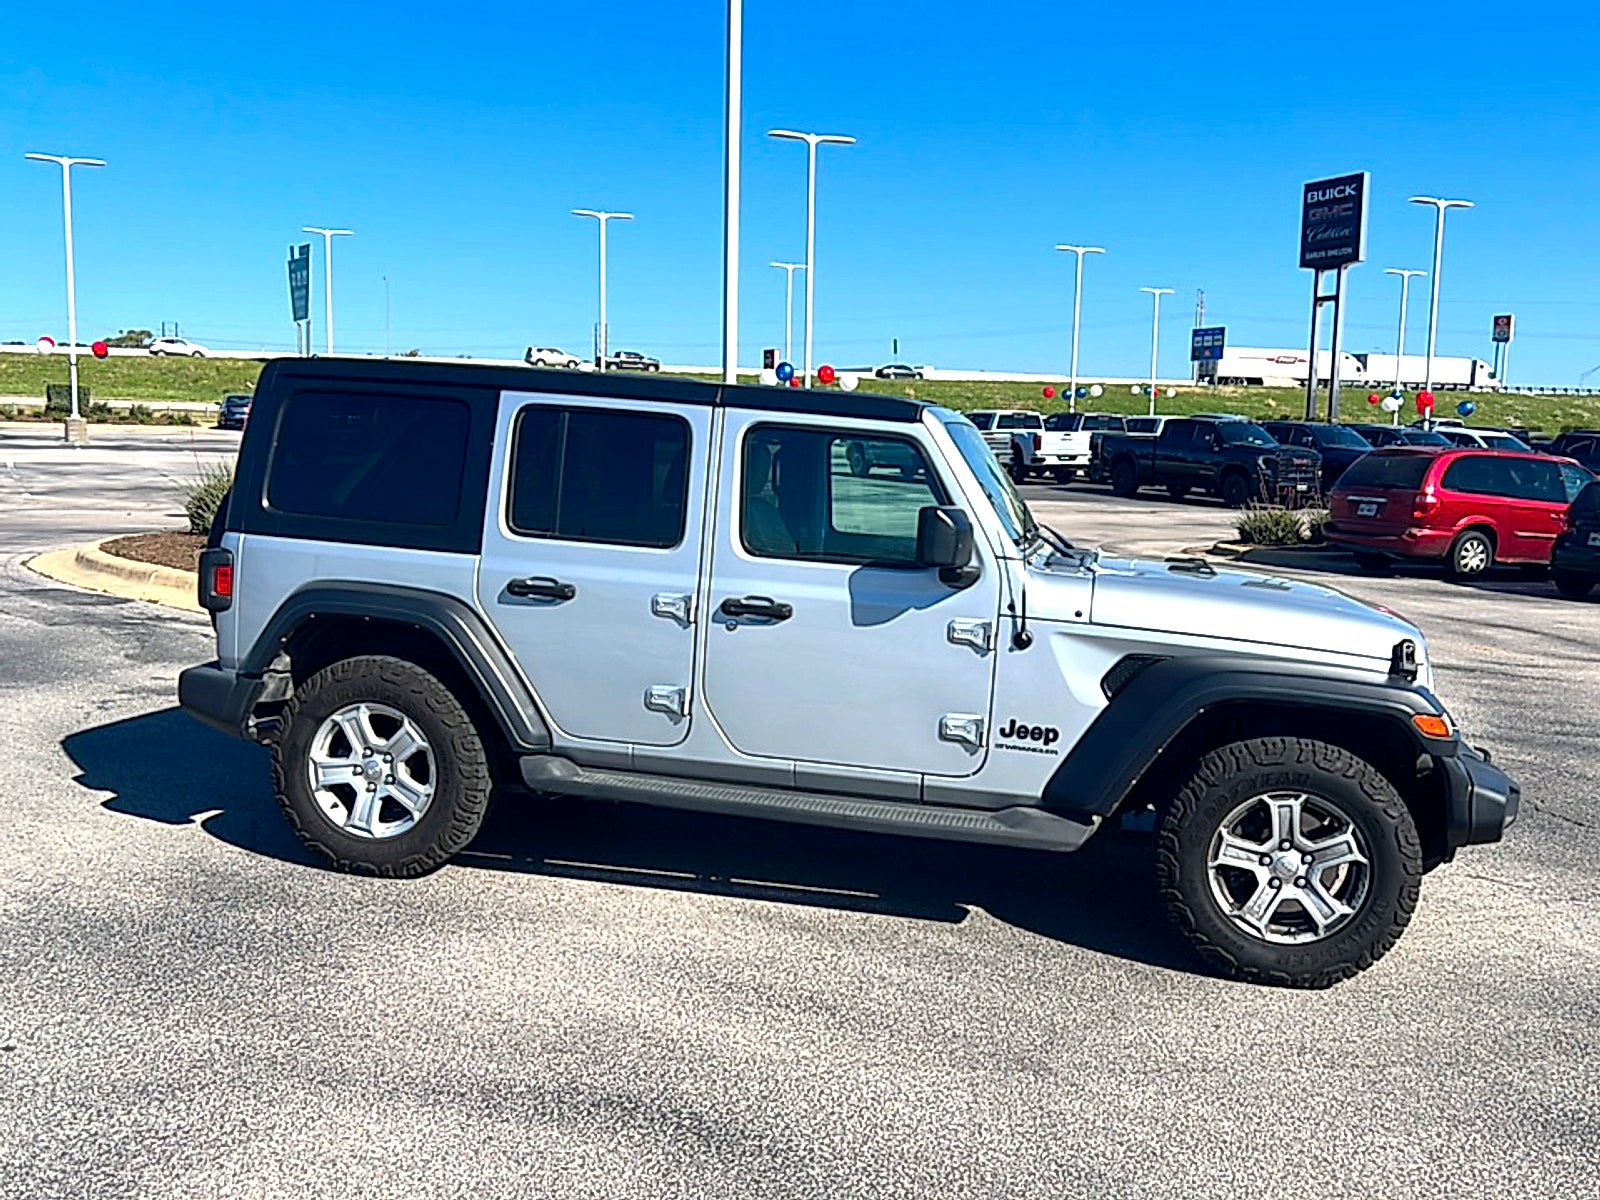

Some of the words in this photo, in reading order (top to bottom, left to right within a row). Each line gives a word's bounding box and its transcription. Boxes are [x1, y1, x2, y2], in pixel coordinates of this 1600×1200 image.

[1307, 183, 1357, 203] BUICK
[1309, 203, 1353, 220] GMC
[999, 718, 1059, 746] Jeep
